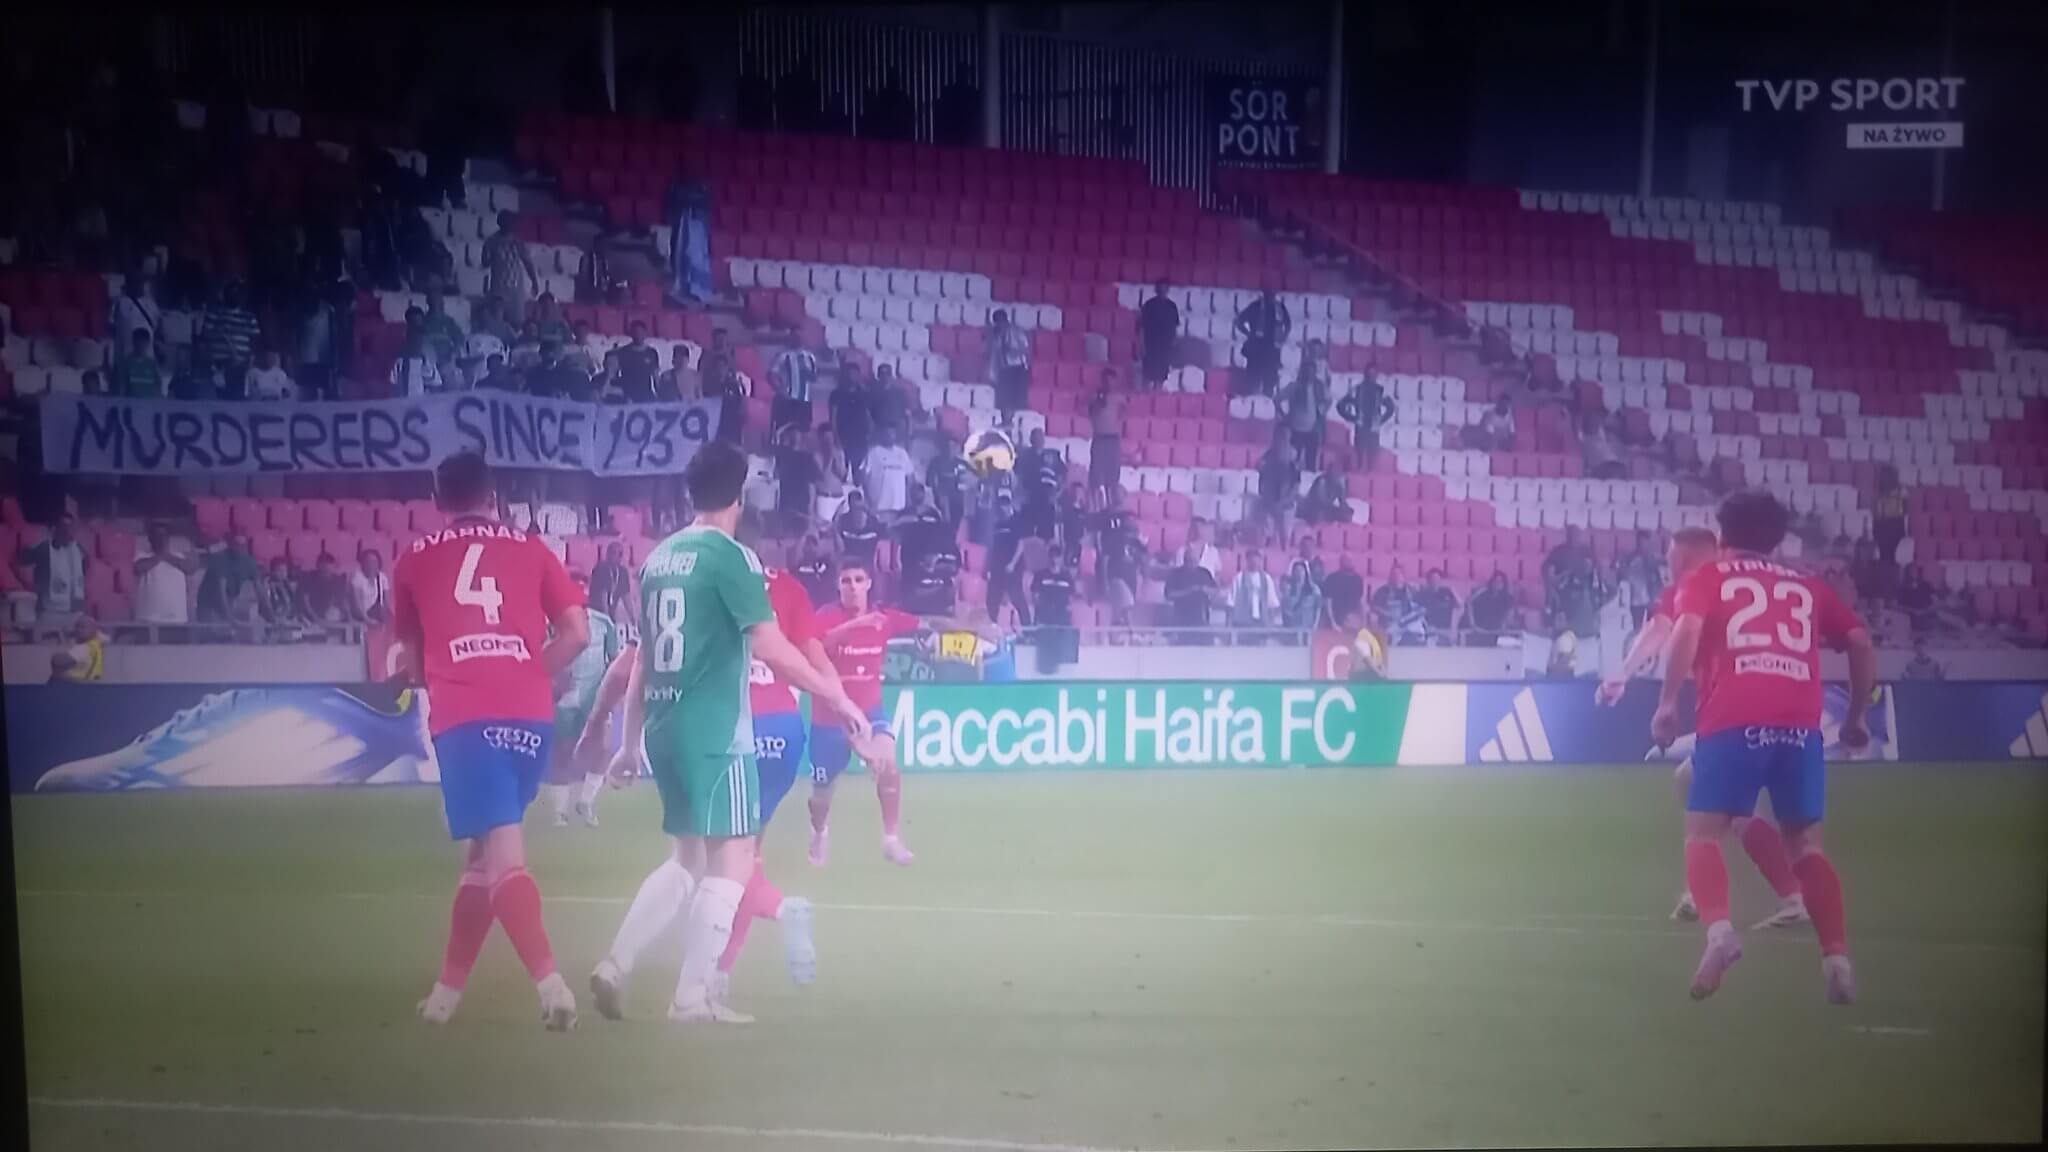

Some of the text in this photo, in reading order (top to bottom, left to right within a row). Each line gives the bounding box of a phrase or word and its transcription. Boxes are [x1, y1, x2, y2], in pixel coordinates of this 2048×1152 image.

[1735, 77, 1965, 111] TVP SPORT
[1219, 122, 1300, 156] PONT
[1863, 126, 1947, 144] NA ŻYWO
[70, 396, 710, 471] MURDERERS SINCE 1939
[454, 543, 504, 625] 4
[1720, 577, 1814, 653] 23
[646, 586, 687, 673] 18
[1125, 688, 1266, 765] Haifa
[1281, 687, 1357, 763] FC
